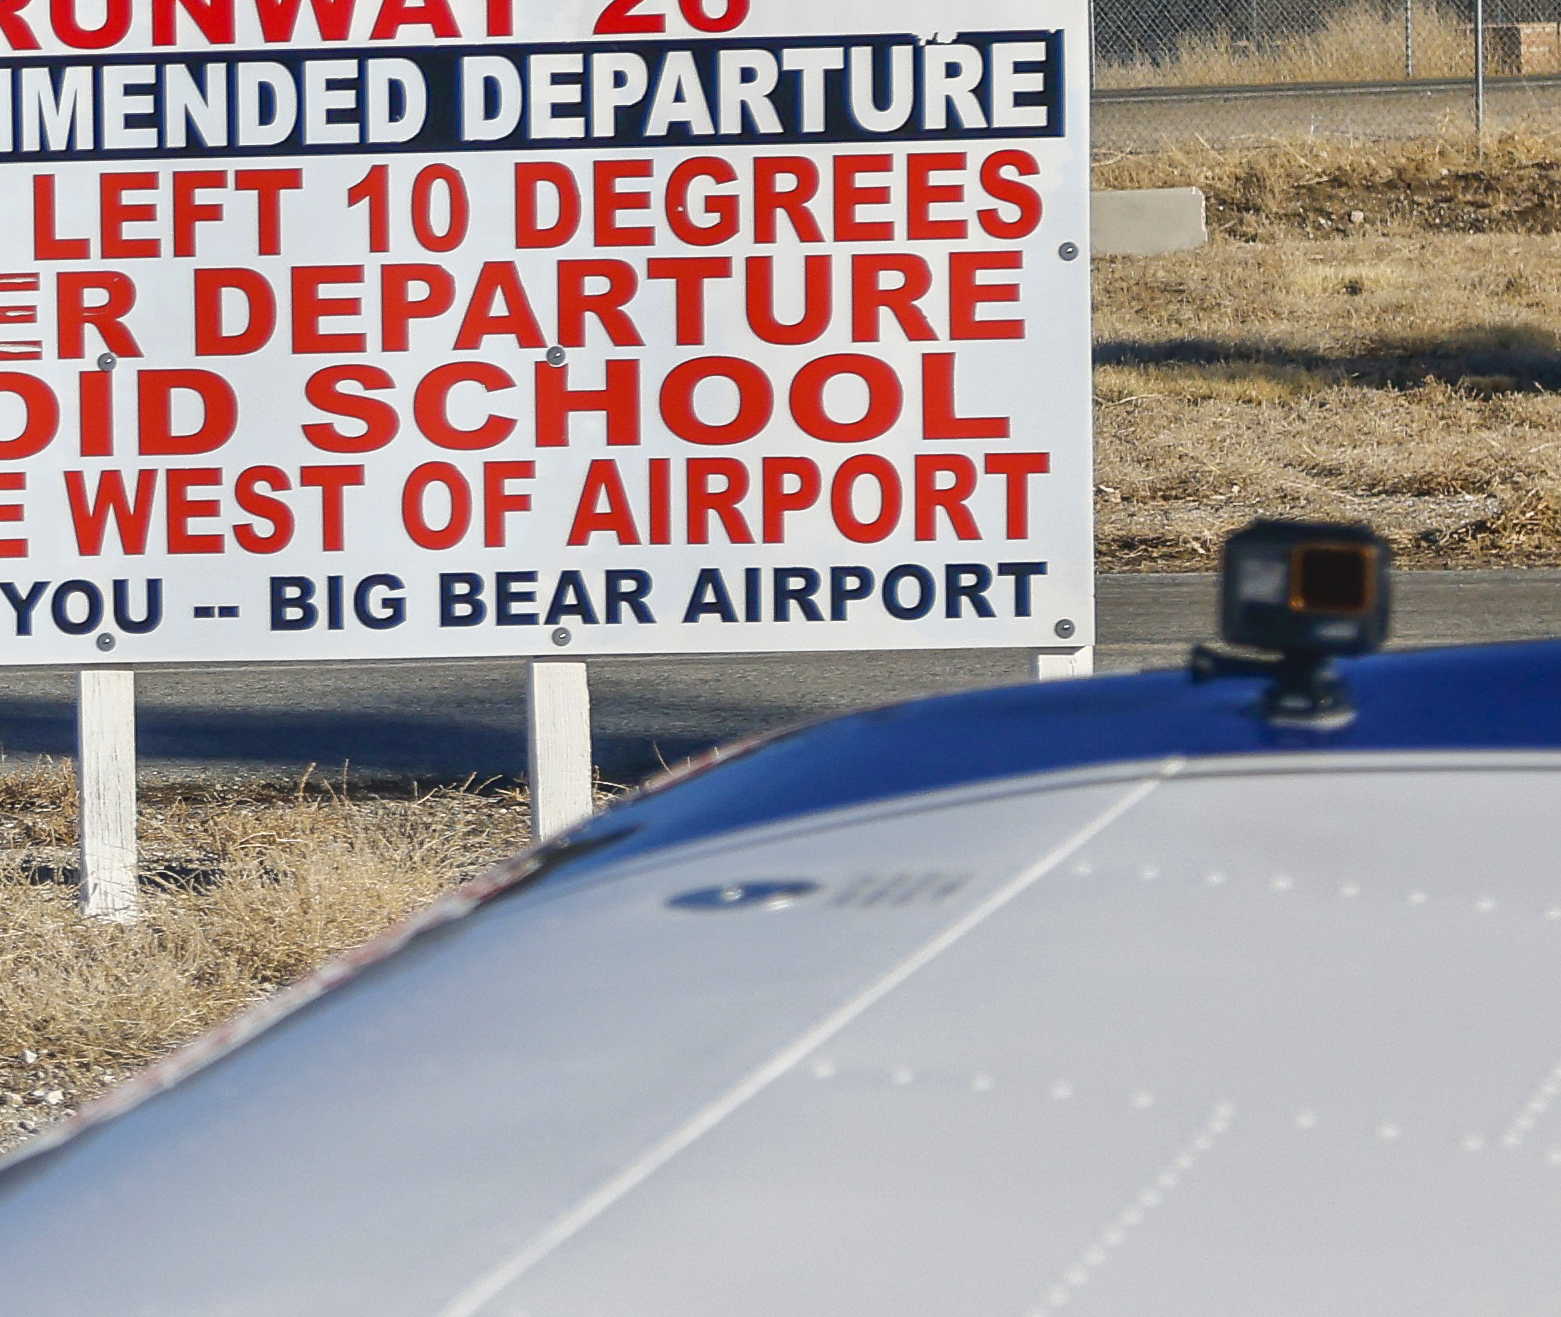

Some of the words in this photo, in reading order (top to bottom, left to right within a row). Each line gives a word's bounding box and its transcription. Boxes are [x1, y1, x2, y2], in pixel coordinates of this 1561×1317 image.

[461, 41, 1049, 142] DEPARTURE
[34, 169, 302, 261] LEFT
[348, 164, 468, 253] 10
[514, 150, 1042, 249] DEGREES
[194, 251, 1024, 357] DEPARTURE
[302, 353, 1010, 454] SCHOOL
[64, 465, 364, 556] WEST
[402, 461, 535, 551] OF
[568, 453, 1050, 546] AIRPORT
[269, 573, 406, 632] BIG
[439, 568, 656, 628] BEAR
[682, 561, 1048, 624] AIRPORT
